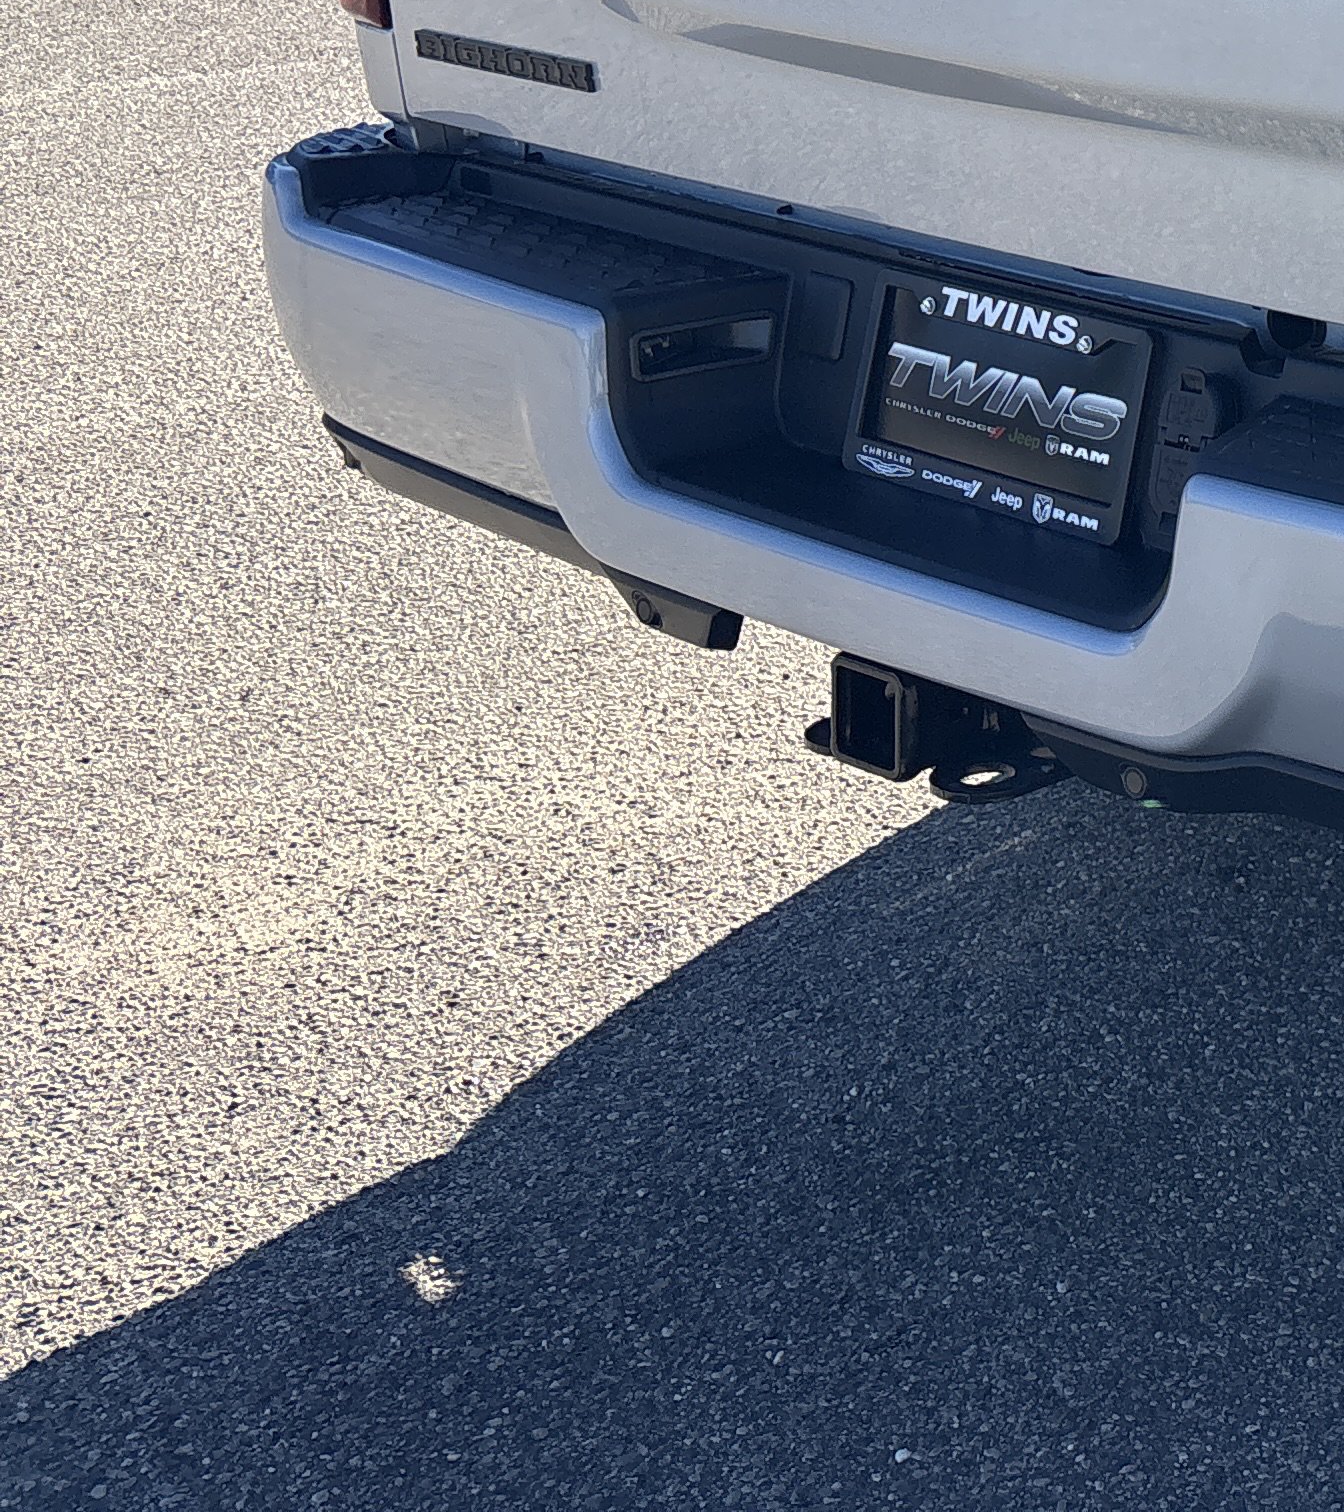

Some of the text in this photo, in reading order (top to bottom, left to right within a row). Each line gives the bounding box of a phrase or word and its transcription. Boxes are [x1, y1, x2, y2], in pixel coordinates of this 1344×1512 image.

[941, 287, 1079, 347] TWINS
[888, 342, 1127, 440] TWINS
[862, 444, 913, 466] CHRYSLER
[885, 397, 1110, 466] CHRYSLER DODGE Jeep RAM
[921, 469, 1099, 532] DODGE Jeep RAM
